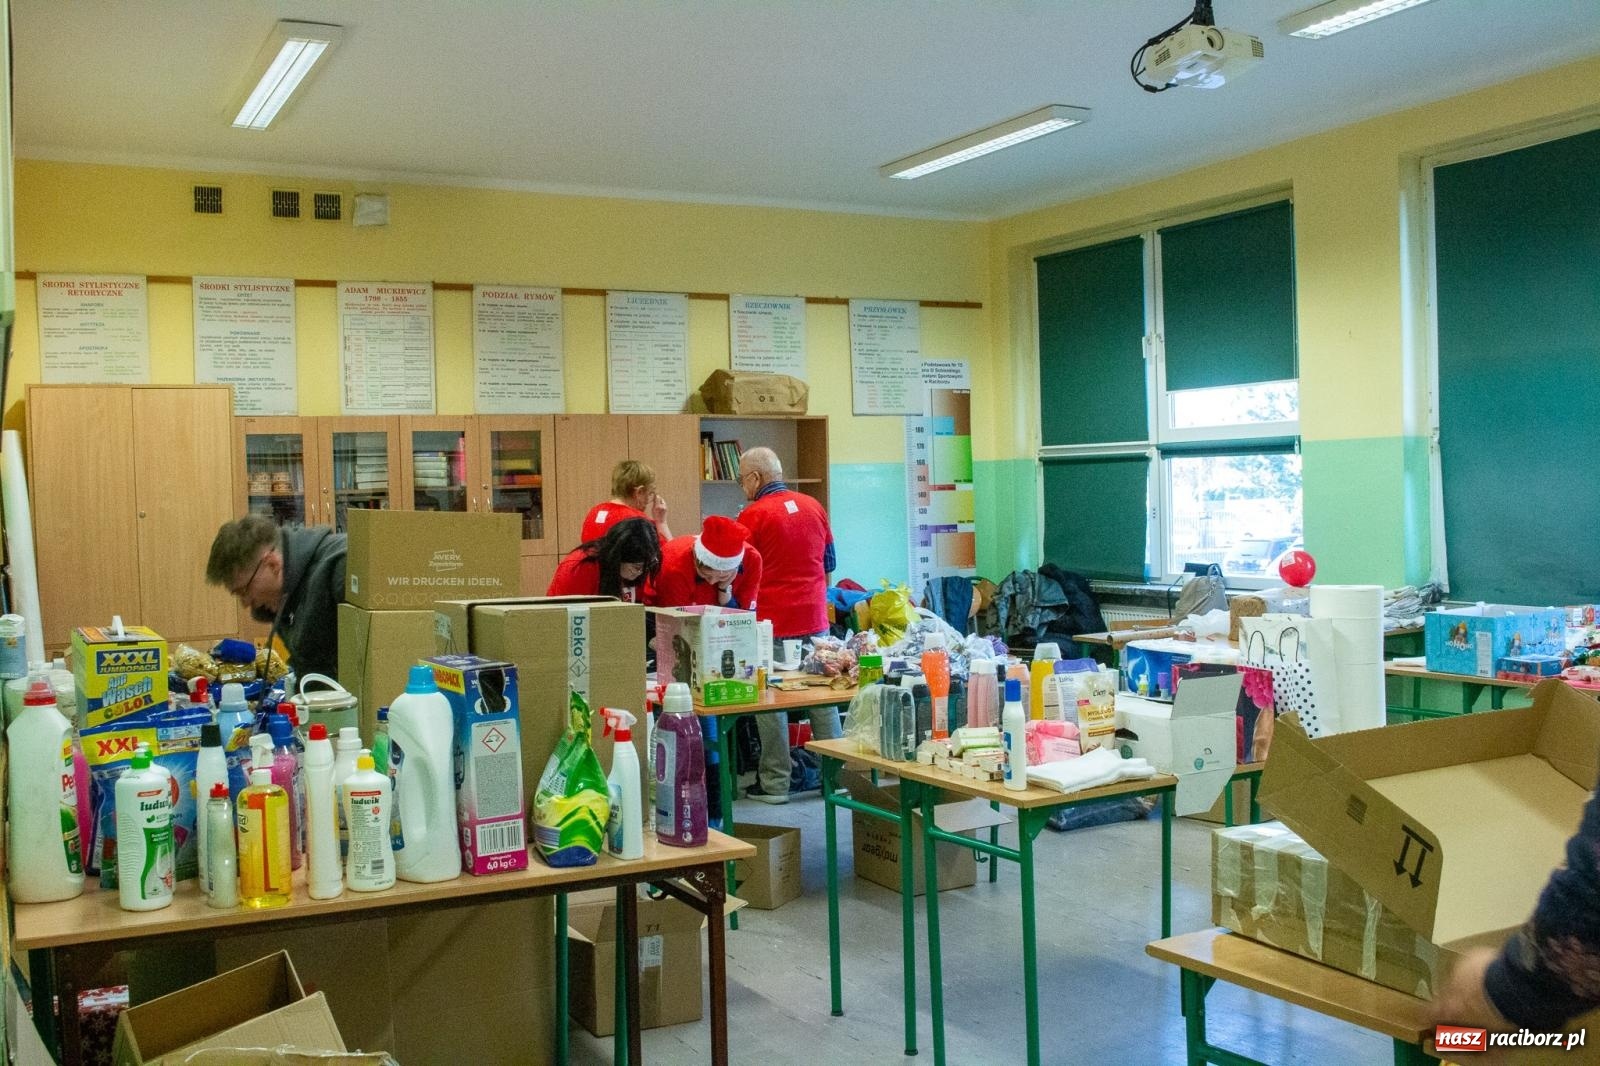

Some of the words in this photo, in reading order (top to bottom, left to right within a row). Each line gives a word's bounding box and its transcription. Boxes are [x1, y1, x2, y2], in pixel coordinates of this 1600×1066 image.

[42, 280, 75, 289] ŚRODKI
[79, 281, 140, 290] STYLISTYCZNE
[199, 282, 230, 291] ŚRODKI
[233, 284, 290, 293] STYLISTYCZNE
[67, 289, 124, 298] RETORYCZNE
[376, 287, 426, 296] MICKIEWICZ
[481, 291, 518, 300] PODZIAŁ
[523, 292, 555, 302] RYMÓW
[626, 296, 669, 305] LICZEBNIK
[745, 302, 791, 310] RZECZOWNIK
[863, 305, 907, 314] PRZYSŁÓWEK
[388, 577, 410, 586] WIR
[414, 577, 464, 586] DRUCKEN
[468, 577, 503, 587] IDEEN.
[726, 619, 752, 627] TASSIMO
[573, 615, 586, 657] beko
[100, 650, 159, 667] XXXL
[99, 664, 159, 674] JUMBOPACK
[102, 677, 152, 708] Wasch
[103, 693, 153, 719] COLOR
[351, 796, 380, 805] ludwik
[487, 861, 498, 871] 6,0
[499, 859, 509, 869] kg
